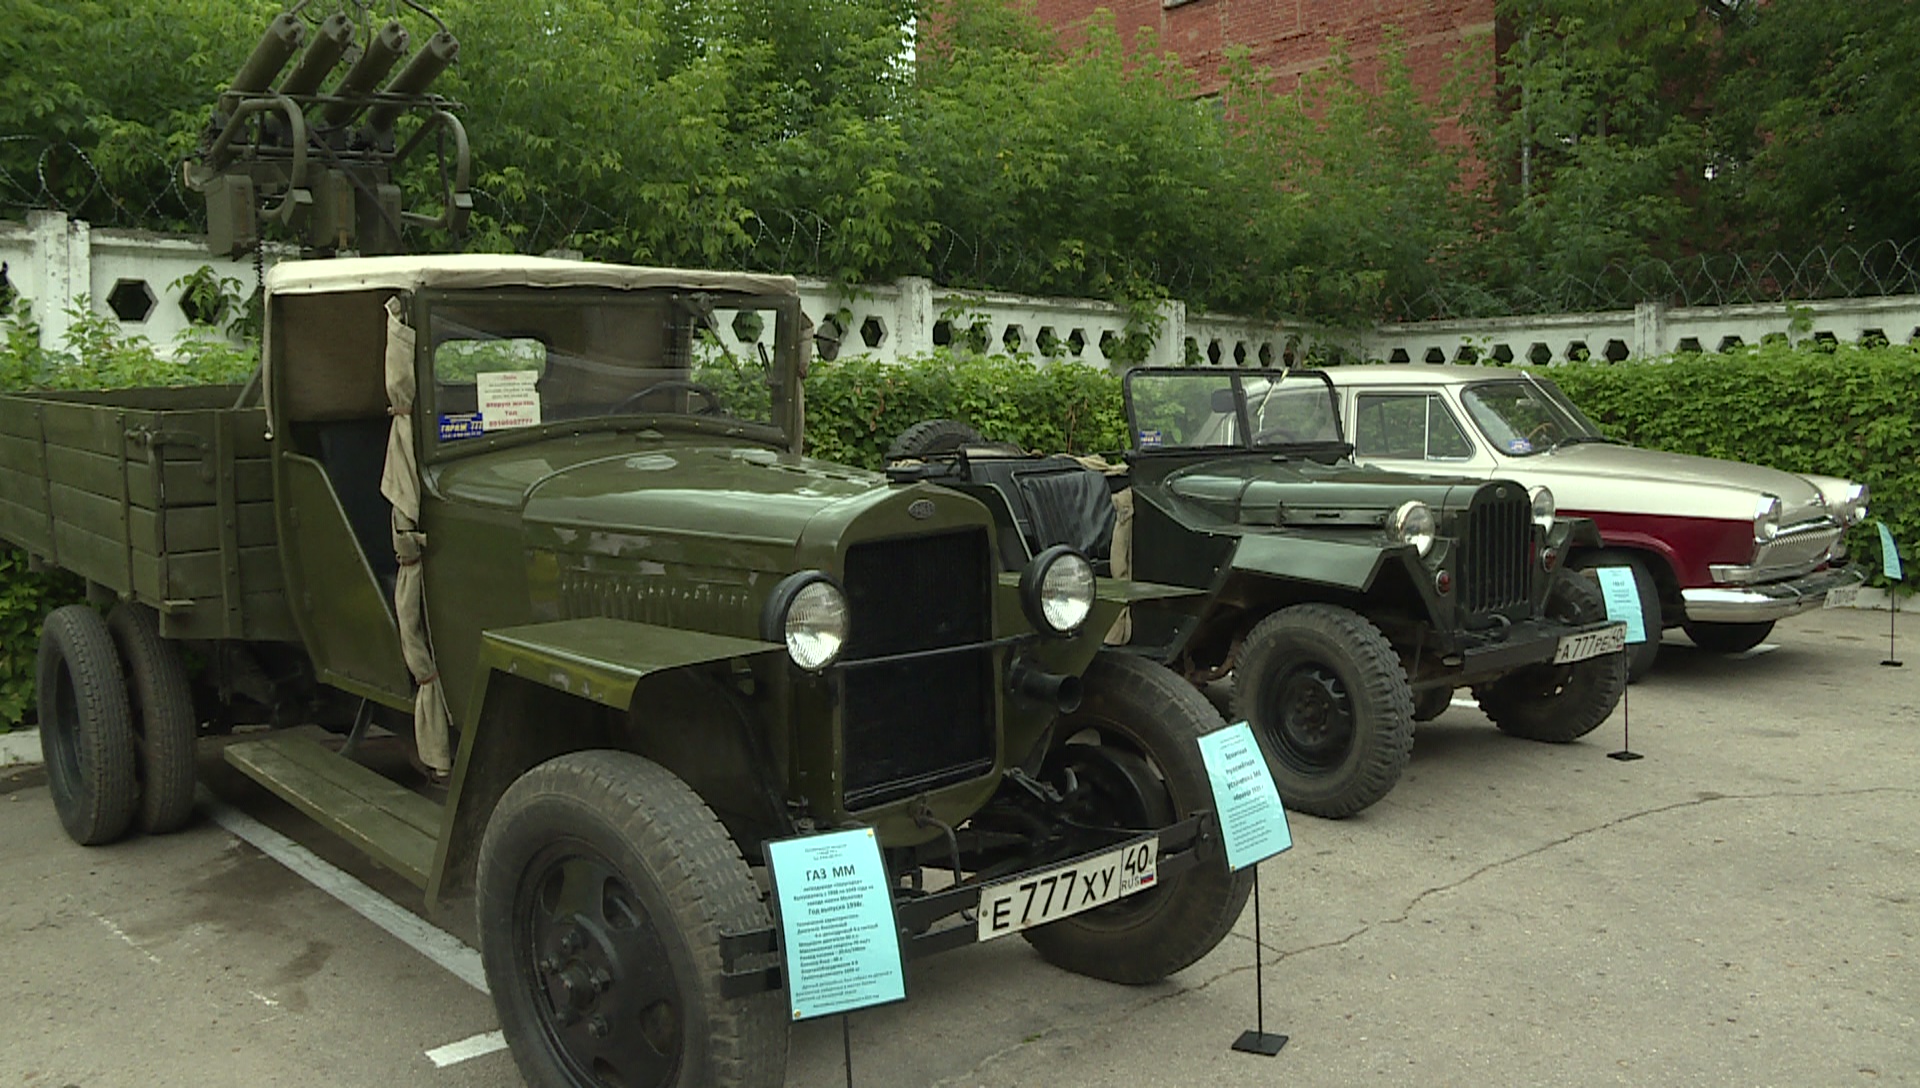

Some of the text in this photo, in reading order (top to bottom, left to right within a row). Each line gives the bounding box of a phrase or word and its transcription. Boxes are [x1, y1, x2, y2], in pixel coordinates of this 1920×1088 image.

[806, 864, 855, 881] ГАЗ ММ
[992, 843, 1149, 931] Е777ХУ 40
[1121, 876, 1140, 891] RUS
[821, 904, 845, 913] выпуска
